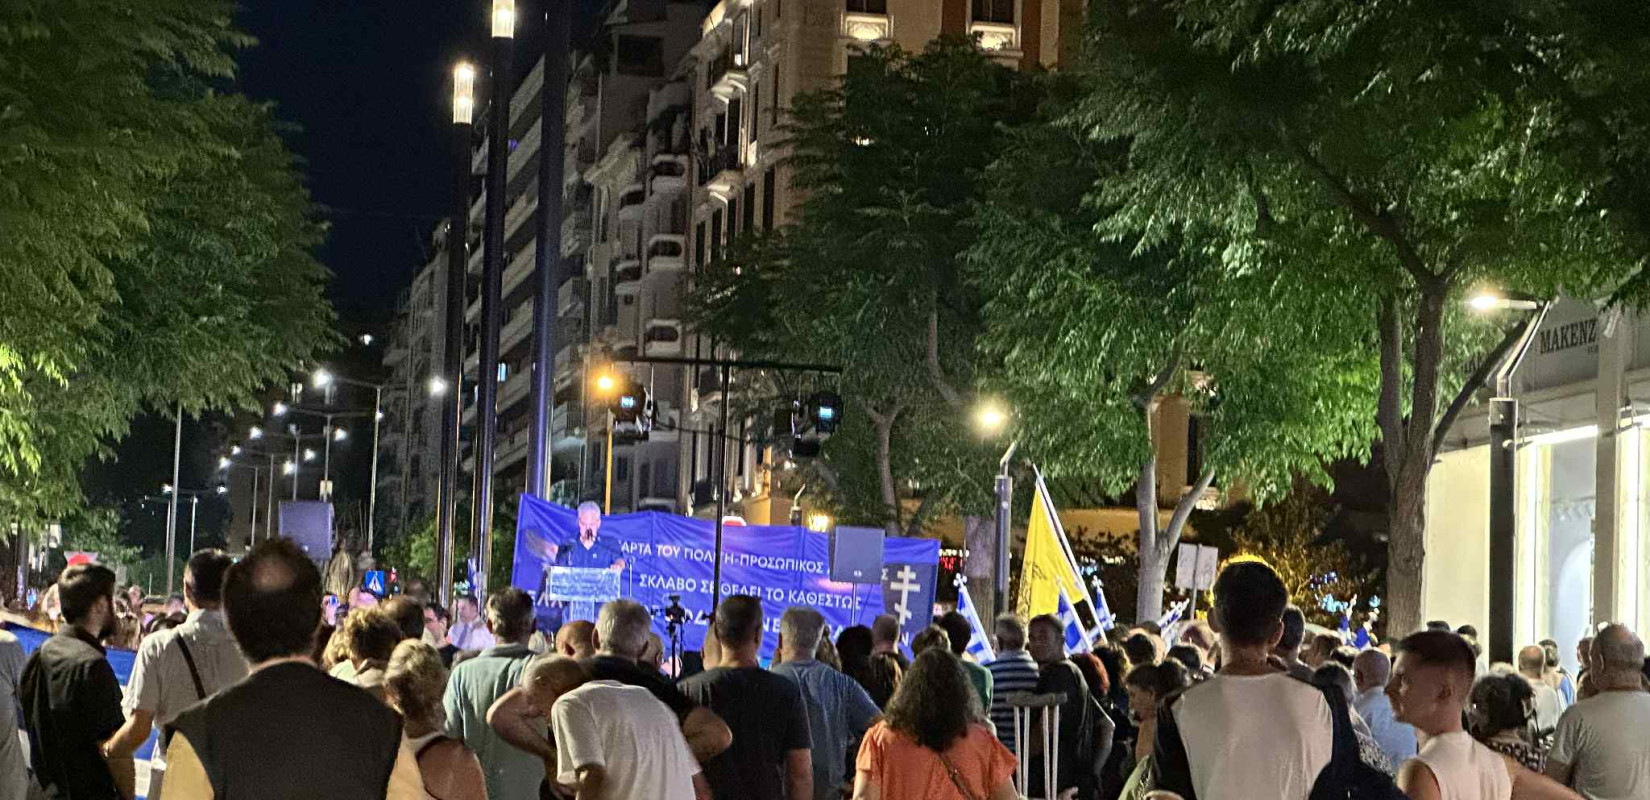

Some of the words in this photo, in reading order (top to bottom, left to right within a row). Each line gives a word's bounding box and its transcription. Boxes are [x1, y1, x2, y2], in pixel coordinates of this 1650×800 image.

[619, 540, 652, 556] ΑΡΤΑ
[656, 544, 681, 558] ΤΟΥ
[639, 574, 697, 592] ΣΚΛΑΒΟ
[765, 587, 784, 602] ΤΟ
[788, 589, 862, 610] ΚΑΘΕΣΤΩΣ
